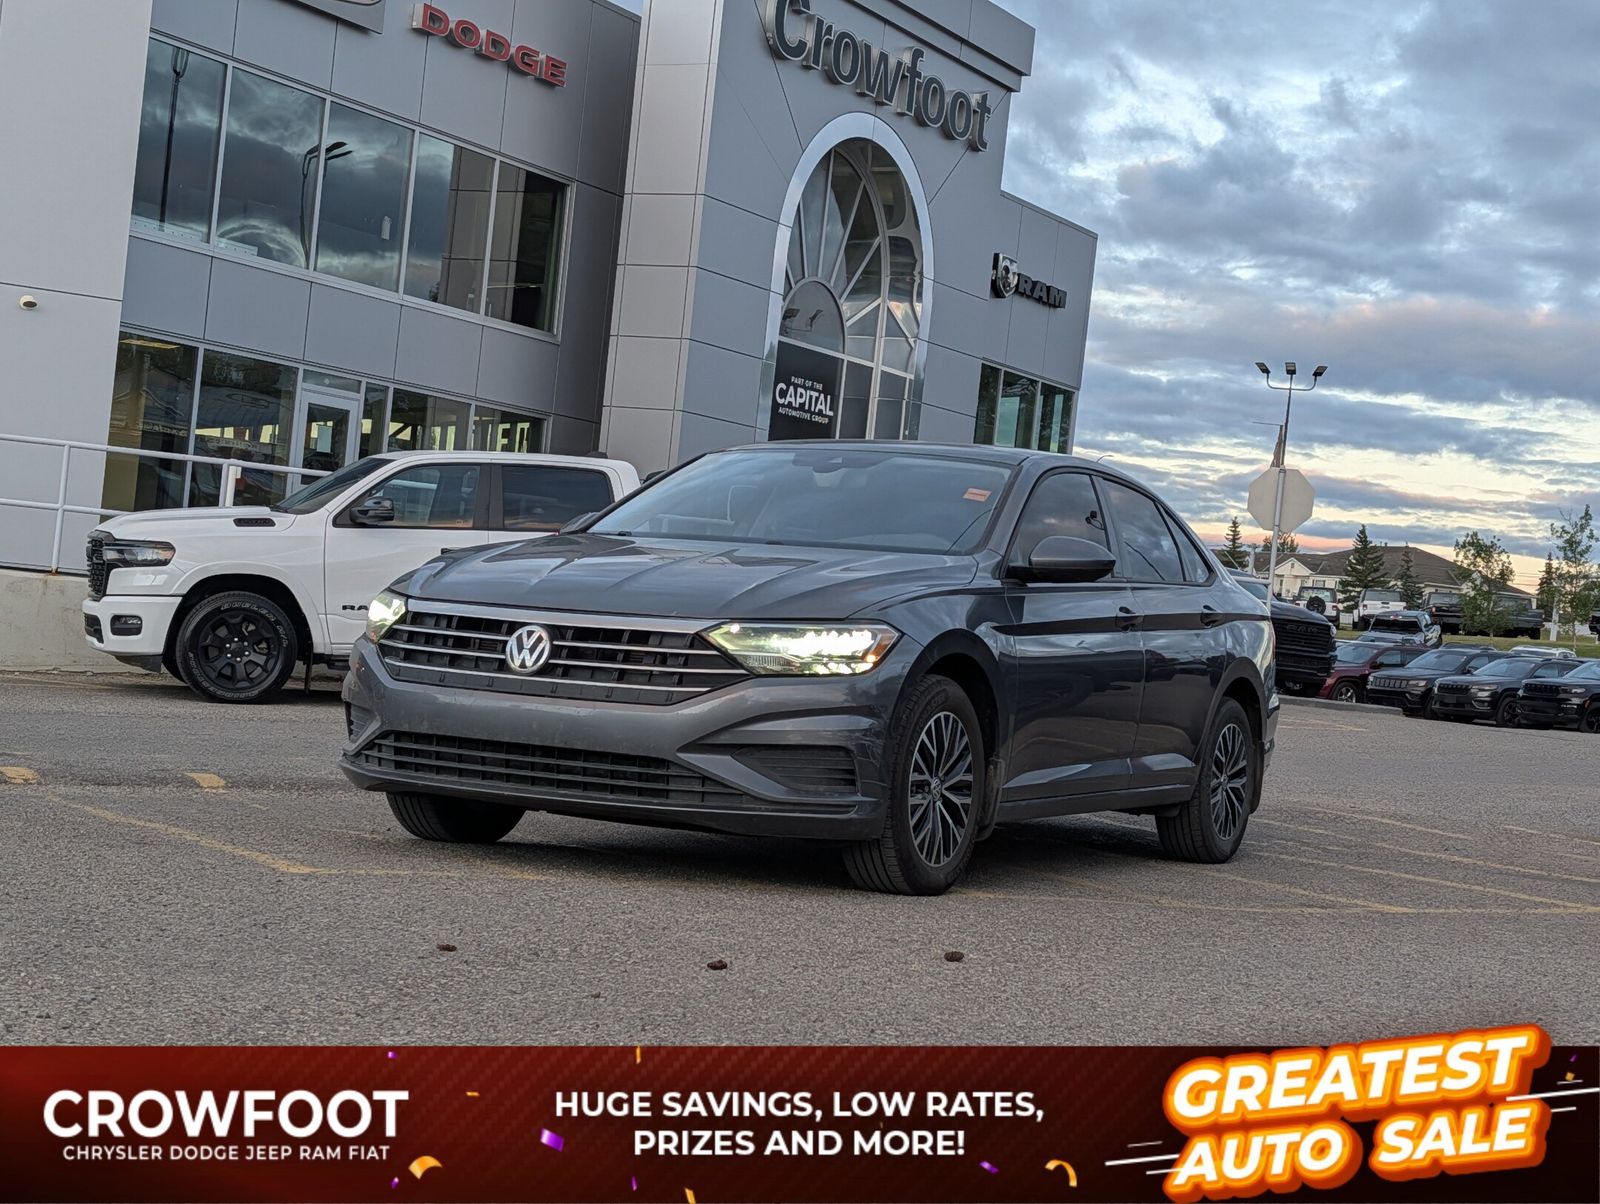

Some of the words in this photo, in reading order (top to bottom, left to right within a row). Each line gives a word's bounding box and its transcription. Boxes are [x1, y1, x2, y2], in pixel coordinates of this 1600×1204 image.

[414, 3, 567, 88] DODGE
[768, 0, 992, 152] Crowfoot
[1018, 273, 1067, 308] RAM
[775, 382, 834, 416] CAPITAL
[791, 376, 805, 386] PART
[813, 381, 823, 390] THE
[778, 407, 811, 421] AUTOMOTIVE
[811, 414, 829, 424] GROUP
